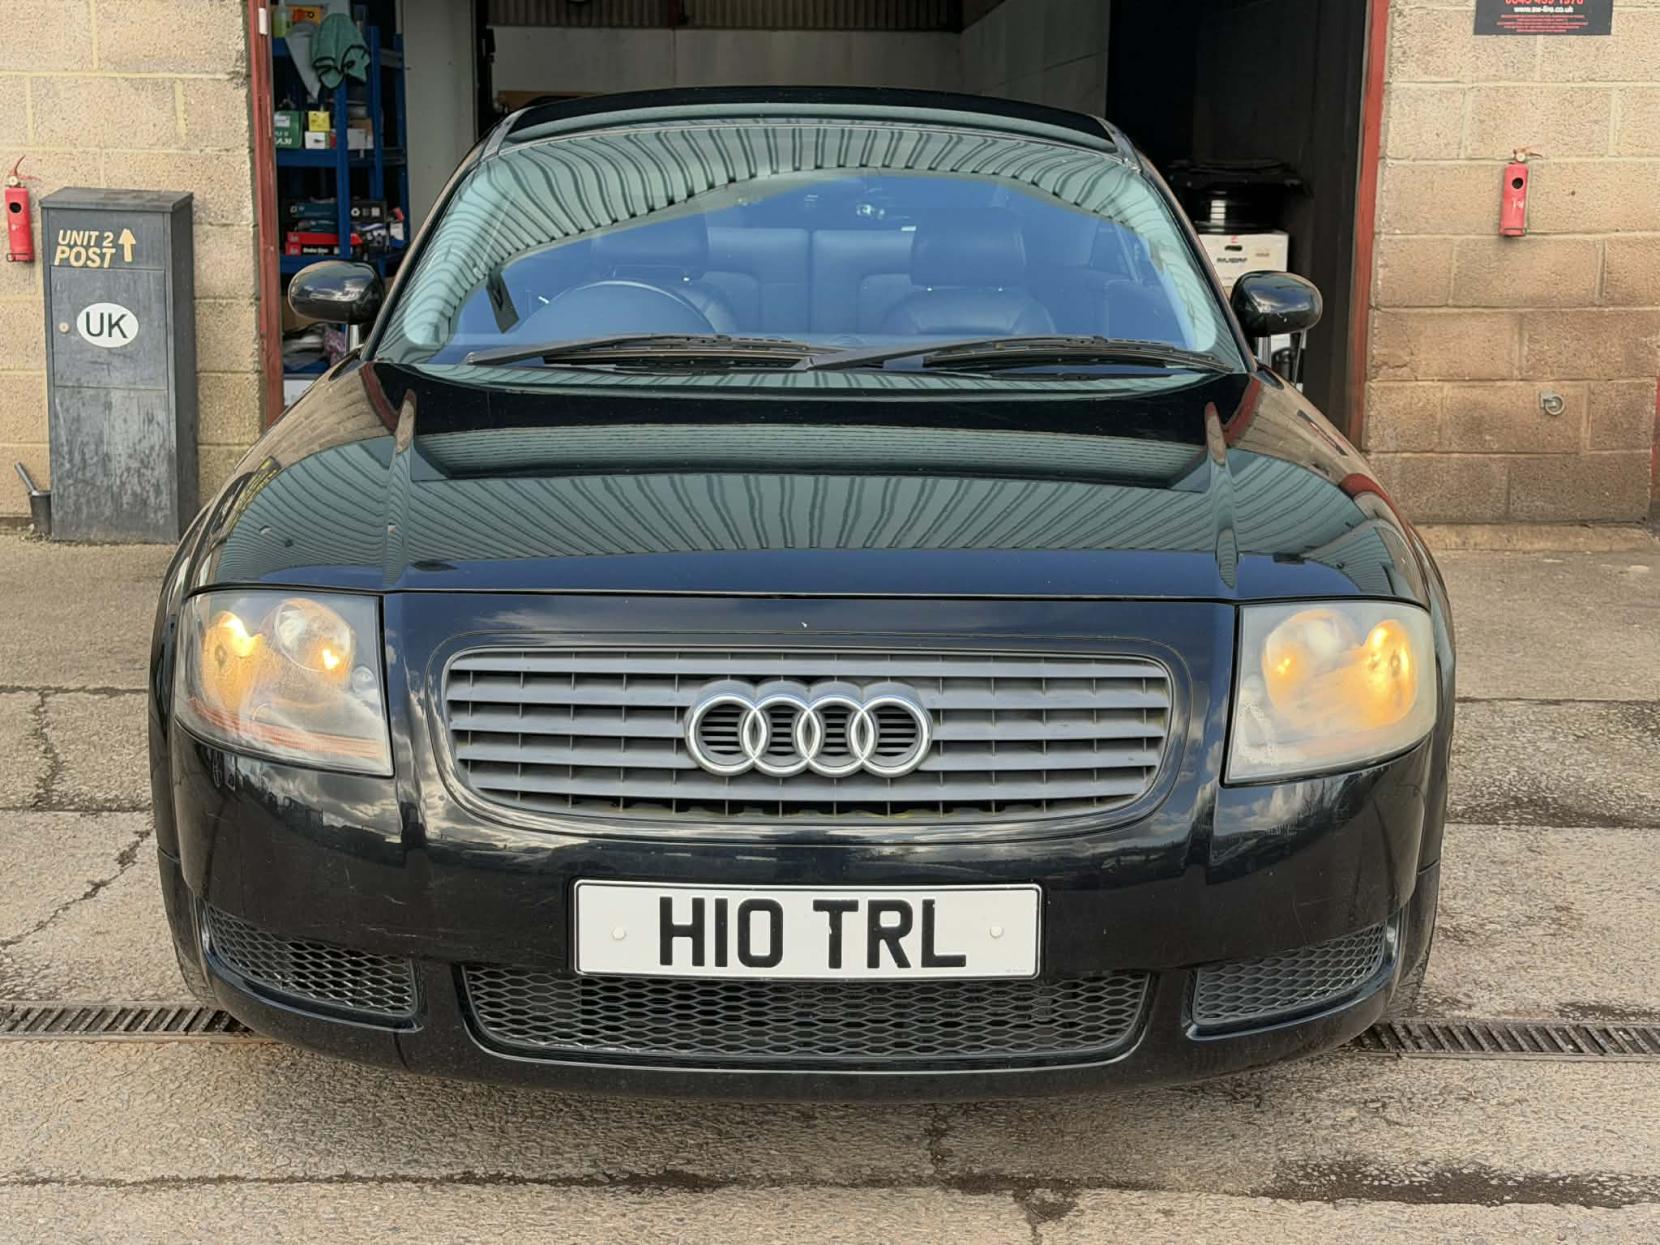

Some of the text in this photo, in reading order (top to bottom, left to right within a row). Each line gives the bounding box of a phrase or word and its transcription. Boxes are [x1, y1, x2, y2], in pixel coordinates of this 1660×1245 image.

[58, 230, 114, 247] UNIT 2
[54, 245, 116, 268] POST
[85, 311, 129, 339] UK
[812, 898, 967, 969] TRL
